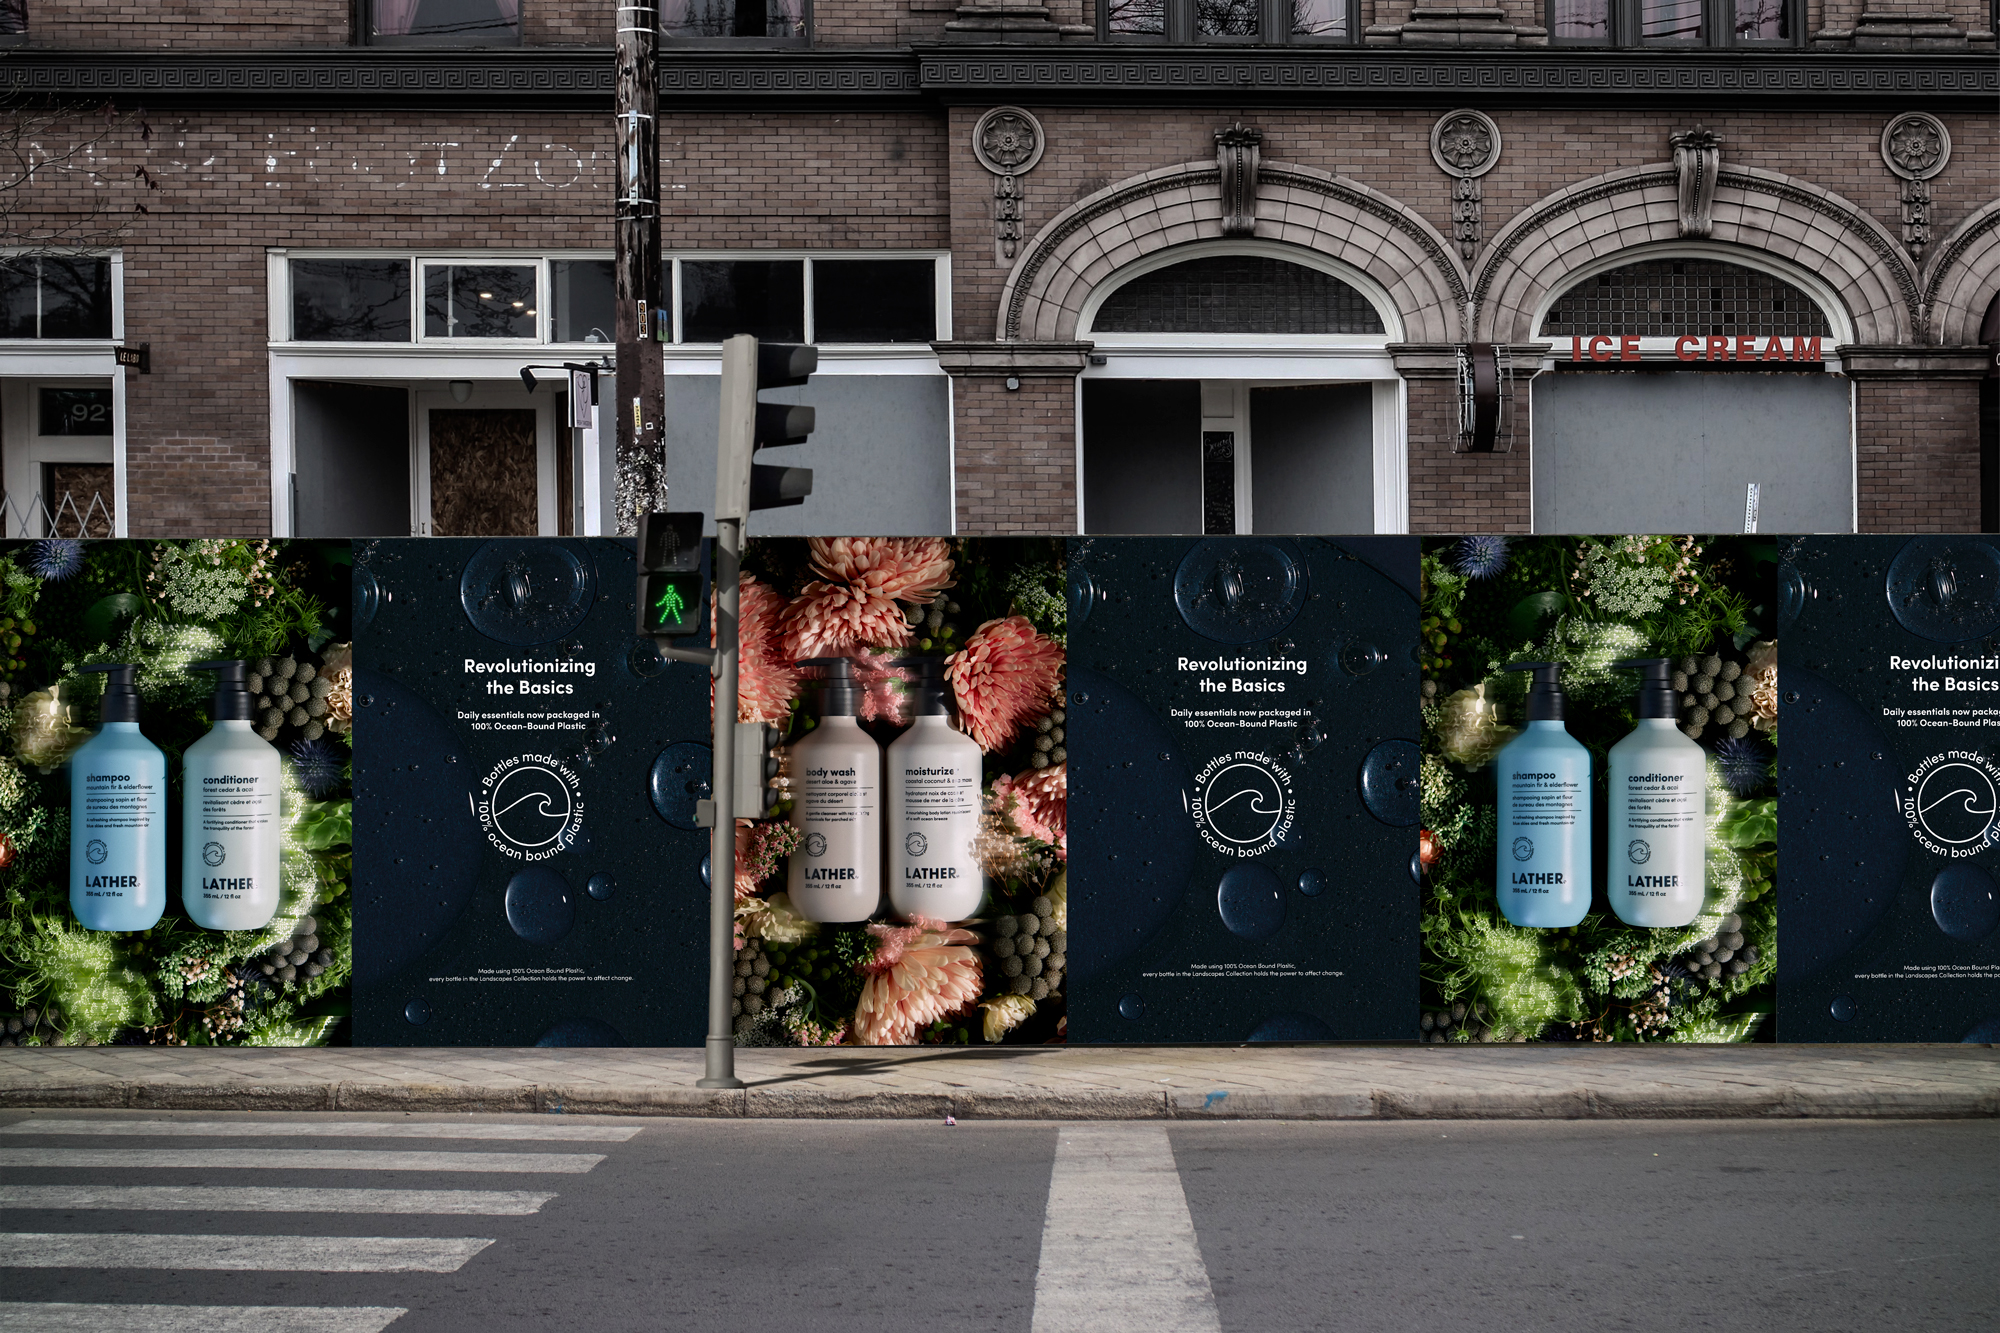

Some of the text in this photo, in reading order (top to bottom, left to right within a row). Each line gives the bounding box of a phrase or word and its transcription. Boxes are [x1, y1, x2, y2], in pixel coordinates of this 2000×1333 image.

[1572, 335, 1822, 362] ICE CREAM
[72, 404, 112, 422] 92
[464, 658, 596, 677] Revolutionizing
[1177, 656, 1307, 675] Revolutionizing
[486, 680, 574, 695] the Basics
[1199, 677, 1286, 693] the Basics
[1911, 676, 1999, 692] the Basics
[457, 711, 480, 721] Daily
[482, 711, 524, 719] essentials
[546, 711, 590, 721] packaged
[1171, 708, 1193, 719] Daily
[1258, 708, 1302, 719] packaged
[1303, 708, 1311, 716] in
[1883, 708, 1906, 717] Daily
[494, 722, 555, 730] Ocean-Bound
[557, 722, 586, 730] Plastic
[1184, 720, 1205, 728] 100%
[1920, 719, 1980, 727] Ocean-Bound
[481, 753, 581, 789] Bottles made with
[806, 767, 855, 779] body wash
[906, 767, 960, 775] moisturize
[1194, 750, 1292, 786] Bottles made with
[1907, 753, 1945, 784] Bottles
[1948, 750, 1984, 765] made
[86, 773, 131, 785] shampoo
[203, 775, 259, 784] conditioner
[1512, 771, 1556, 782] shampoo
[1628, 773, 1685, 782] conditioner
[478, 800, 584, 861] 100% ocean bound plastic
[1191, 797, 1296, 858] 100% ocean bound plastic
[1904, 797, 1919, 828] 100%
[1913, 829, 1948, 857] ocean
[1951, 837, 1992, 858] bound
[805, 867, 856, 880] LATHER
[905, 867, 956, 879] LATHER
[1512, 872, 1564, 885] LATHER
[85, 875, 138, 888] LATHER
[202, 877, 254, 890] LATHER
[1628, 875, 1679, 888] LATHER
